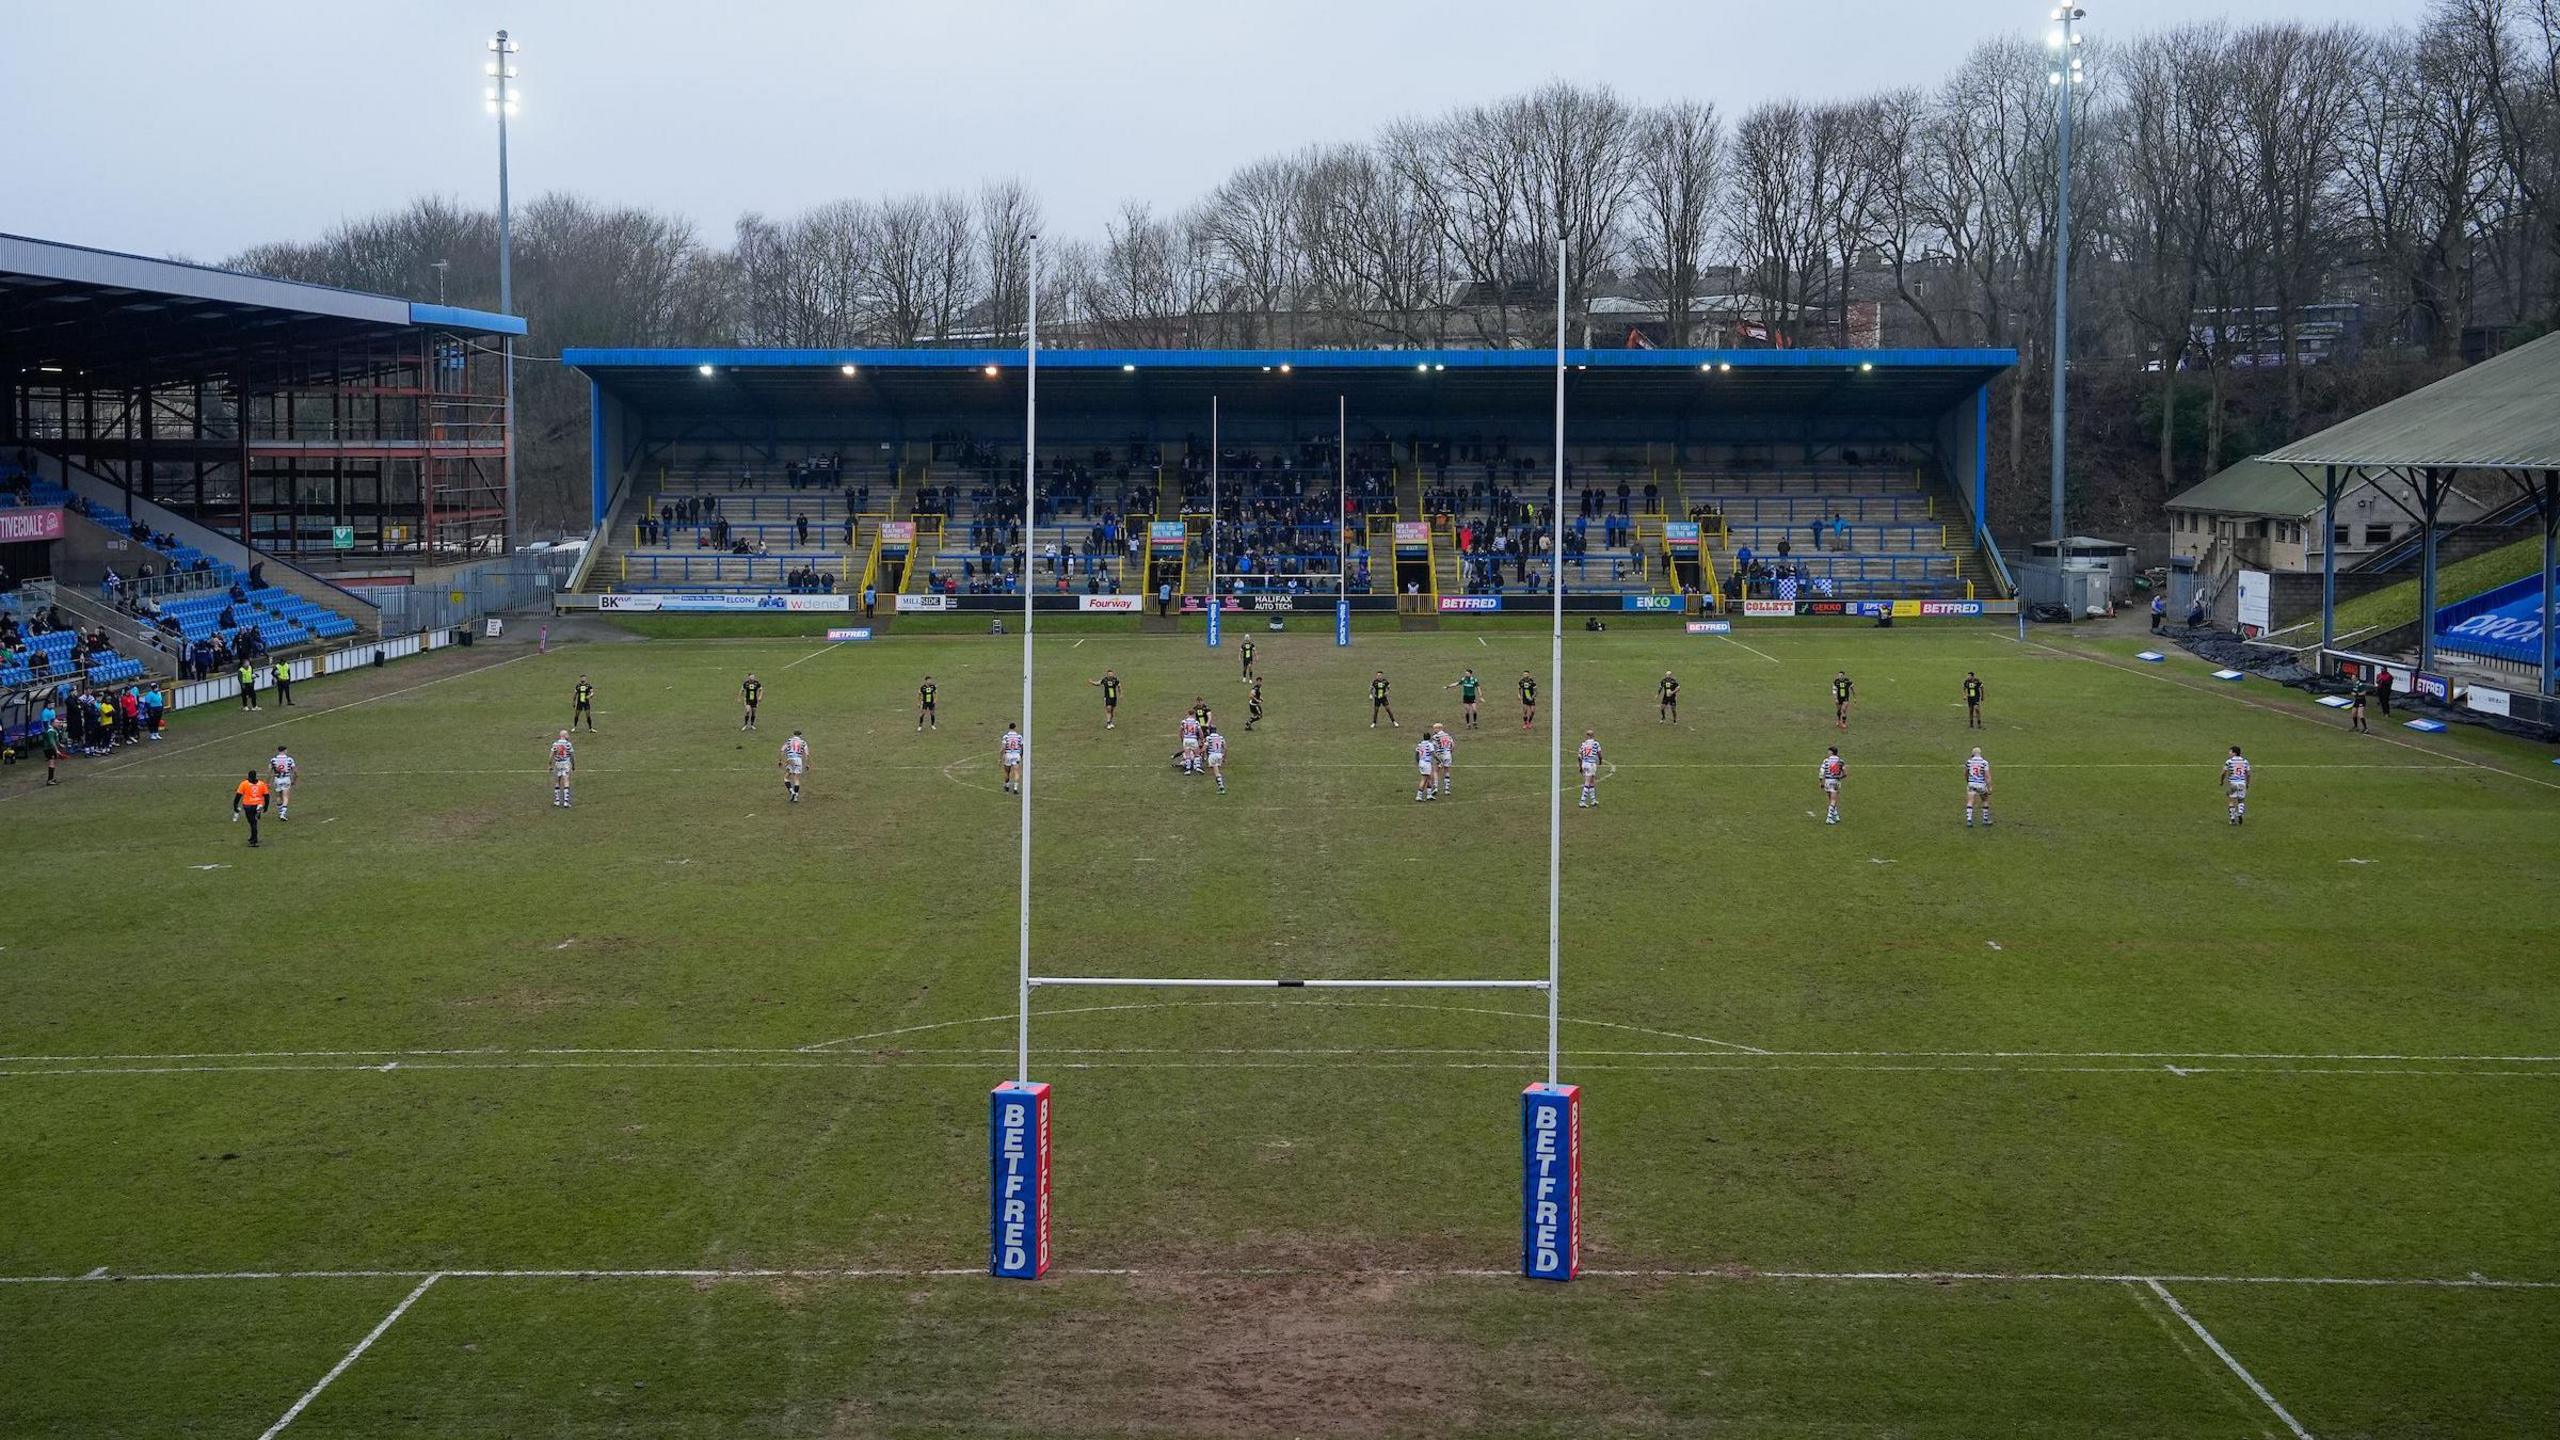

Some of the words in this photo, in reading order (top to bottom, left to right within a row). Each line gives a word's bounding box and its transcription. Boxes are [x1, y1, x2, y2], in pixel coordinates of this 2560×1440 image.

[1089, 598, 1132, 609] Fourway
[1255, 595, 1293, 603] HALIFAX
[1442, 598, 1497, 609] BETFRED
[1637, 597, 1671, 608] ENCO
[1746, 602, 1793, 611] COLLETT
[1923, 603, 1980, 614] BETFRED
[1689, 623, 1728, 631] BETFRED
[1004, 1104, 1026, 1270] BETFRED
[1040, 1099, 1048, 1267] BETFRED
[1536, 1105, 1559, 1272] BETFRED
[1571, 1101, 1579, 1270] BETFRED
